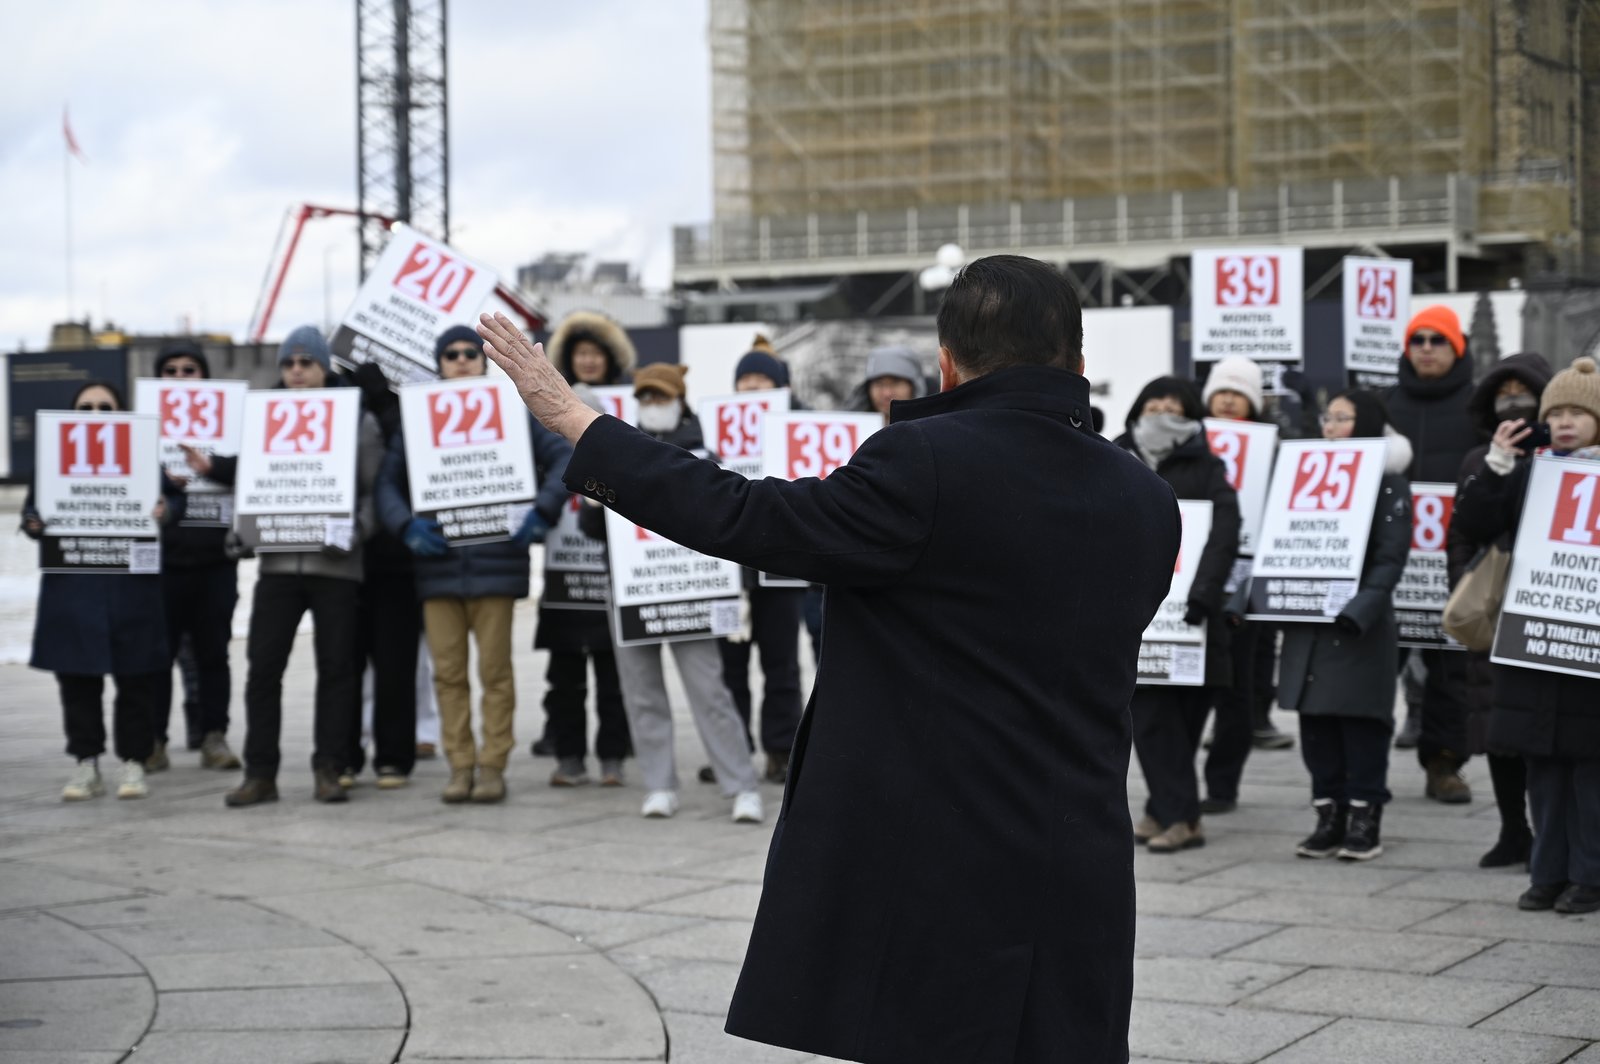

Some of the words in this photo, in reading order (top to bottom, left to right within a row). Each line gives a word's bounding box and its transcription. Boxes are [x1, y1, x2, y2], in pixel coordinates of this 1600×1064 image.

[398, 248, 466, 310] 20
[1221, 256, 1275, 306] 39
[1361, 268, 1394, 319] 25
[1222, 313, 1272, 323] MONTHS
[419, 327, 436, 342] FO
[1209, 328, 1257, 338] WAITING
[164, 391, 218, 438] 33
[435, 387, 499, 446] 22
[269, 400, 327, 453] 23
[720, 403, 762, 456] 39
[68, 422, 122, 475] 11
[792, 424, 851, 480] 39
[269, 461, 323, 472] MONTHS
[441, 450, 498, 467] MONTHS
[254, 477, 307, 488] WAITING
[311, 477, 336, 487] FOR
[427, 468, 485, 485] WAITING
[488, 464, 515, 477] FOR
[1291, 451, 1356, 510] 25
[70, 484, 128, 496] MONTHS
[421, 489, 450, 502] IRCC
[453, 480, 525, 498] RESPONSE
[56, 501, 112, 511] WAITING
[116, 501, 142, 511] FOR
[275, 494, 344, 504] RESPONSE
[1562, 475, 1600, 544] 1
[79, 518, 150, 528] RESPONSE
[256, 515, 273, 529] NO
[436, 510, 455, 526] NO
[1289, 518, 1340, 532] MONTHS
[260, 529, 277, 543] NO
[278, 529, 325, 543] RESULTS
[443, 522, 461, 538] NO
[59, 538, 76, 551] NO
[1273, 537, 1322, 550] WAITING
[1325, 537, 1349, 550] FOR
[64, 551, 81, 564] NO
[83, 552, 130, 565] RESULTS
[1289, 555, 1352, 570] RESPONSE
[1410, 557, 1446, 571] NTHS
[1551, 551, 1600, 573] MONT
[631, 562, 690, 578] WAITING
[694, 560, 721, 572] FOR
[657, 576, 730, 594] RESPONSE
[1266, 579, 1283, 595] NO
[1434, 574, 1450, 586] FO
[1530, 569, 1598, 594] WAITING
[1267, 595, 1284, 609] NO
[1395, 591, 1450, 605] RESPON
[1514, 589, 1551, 609] IRCC
[639, 605, 658, 621] NO
[645, 619, 664, 634] NO
[1523, 620, 1546, 638] NO
[1546, 623, 1600, 647] TIMELIN
[1526, 638, 1548, 656] NO
